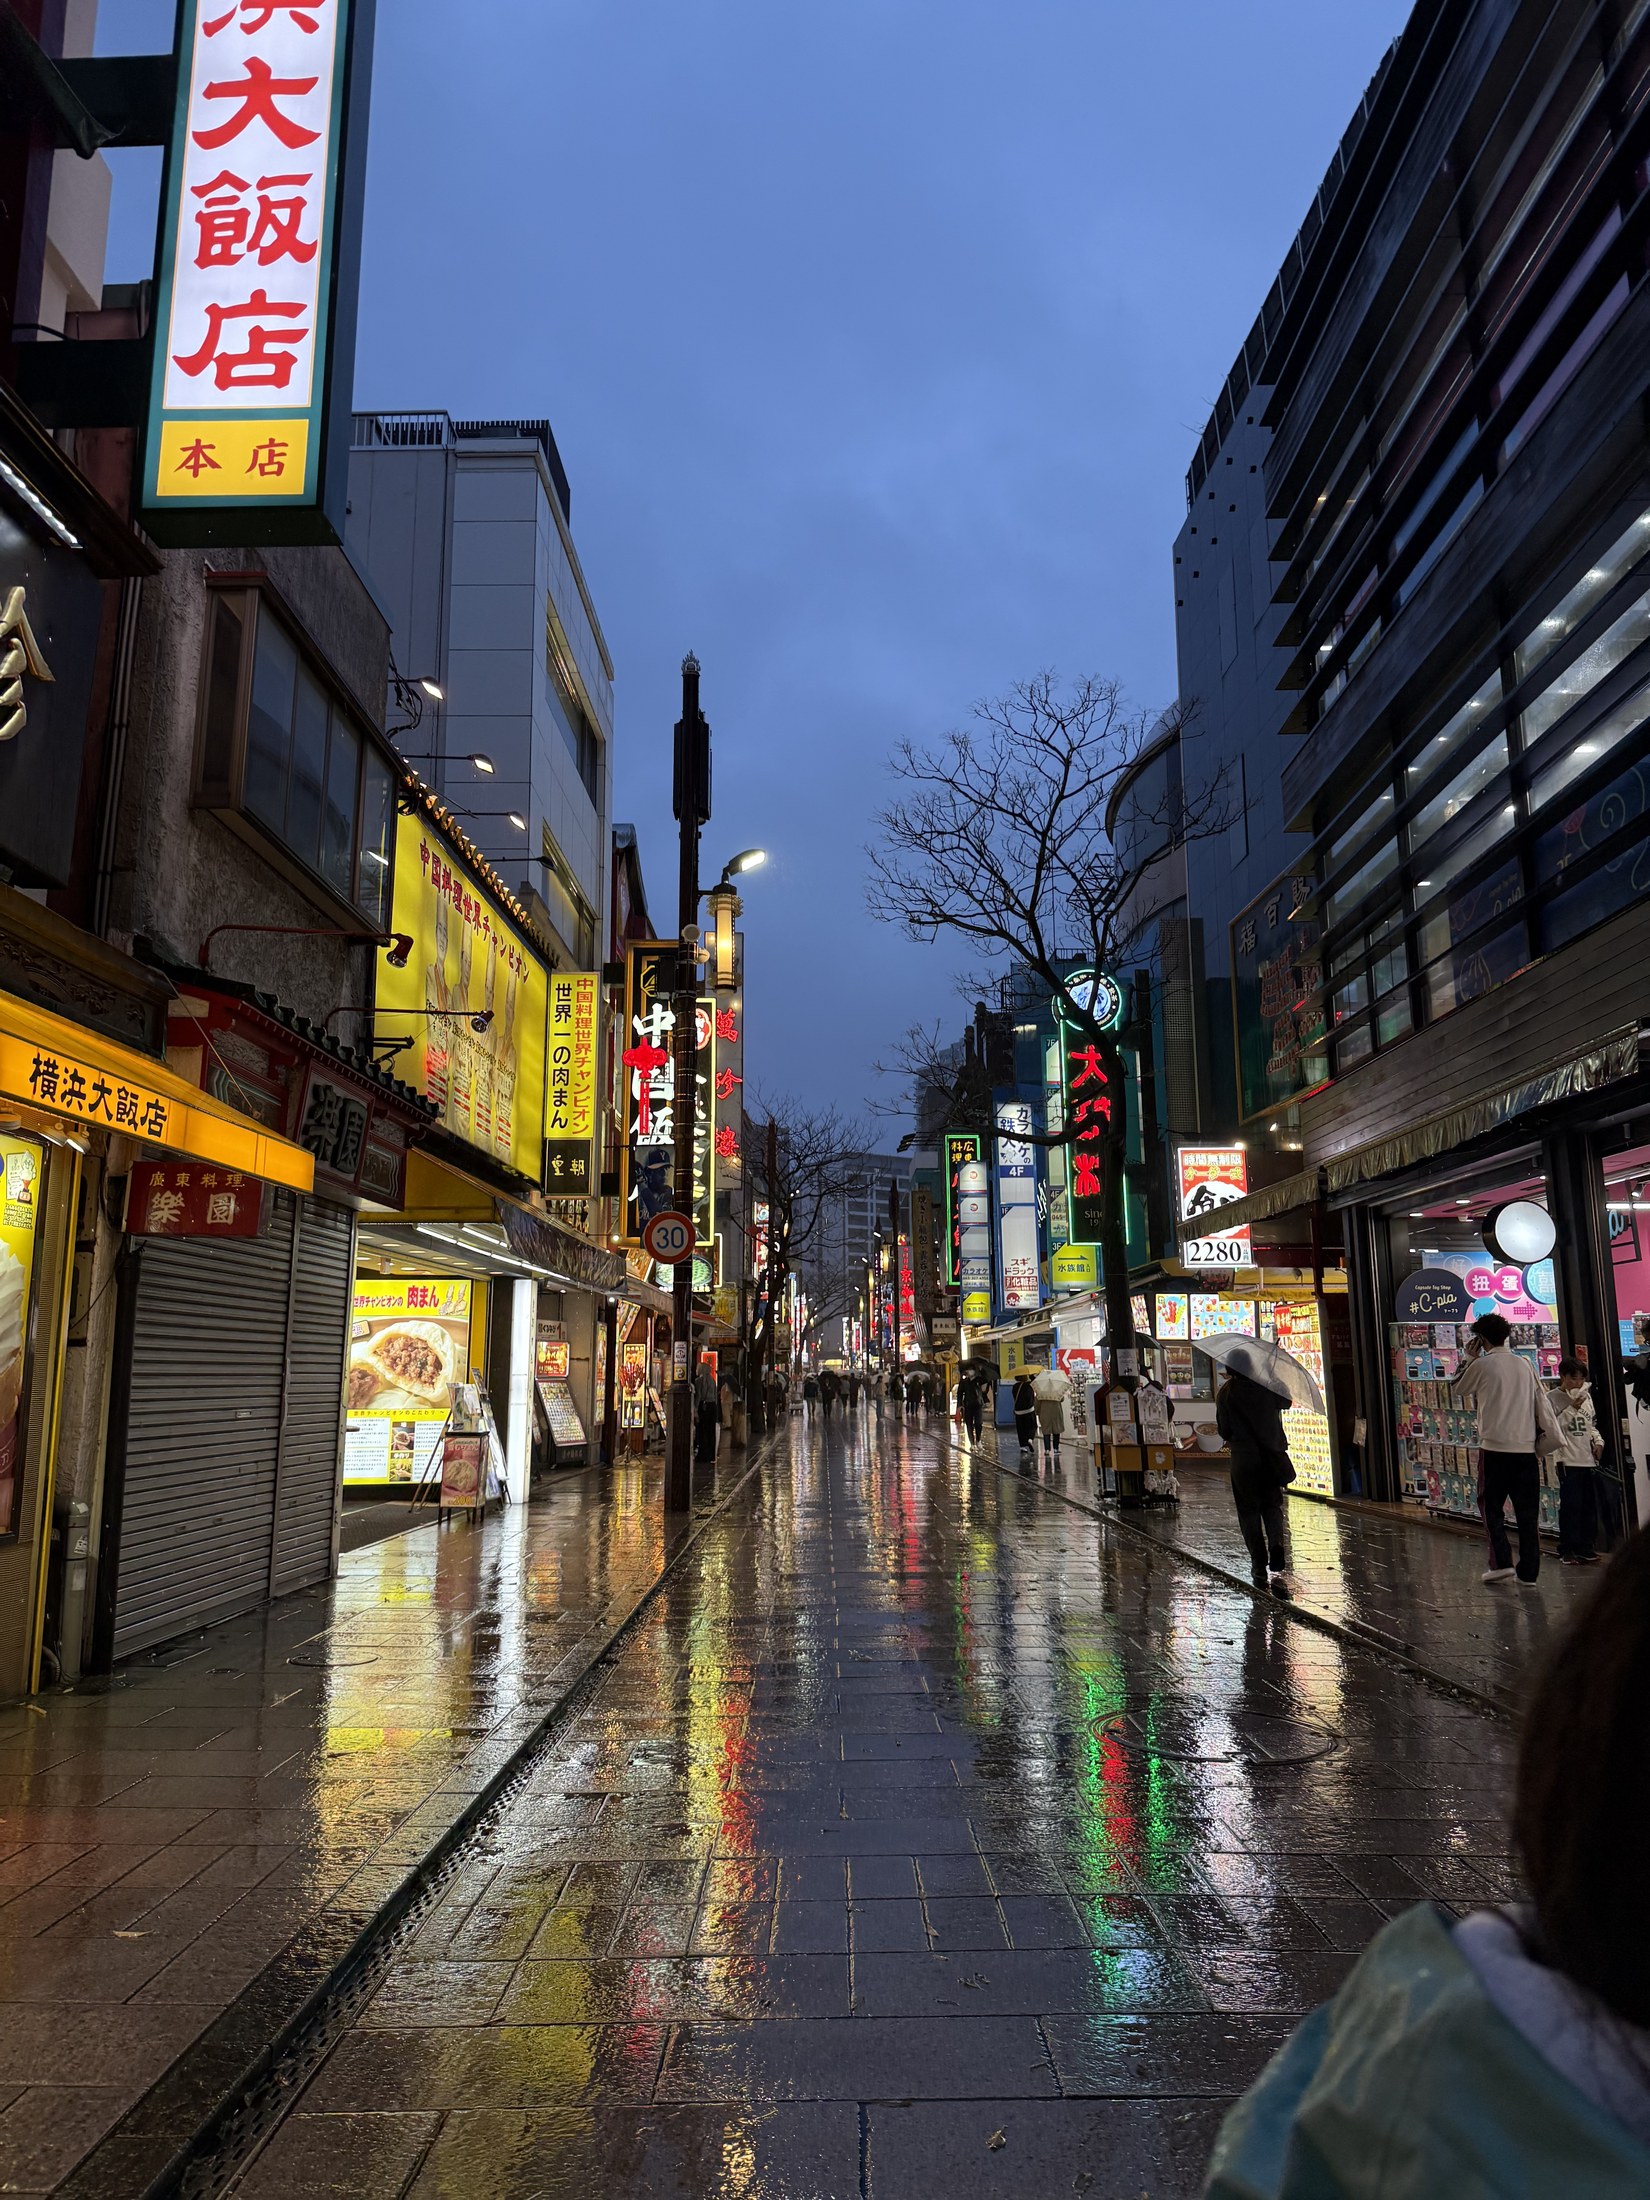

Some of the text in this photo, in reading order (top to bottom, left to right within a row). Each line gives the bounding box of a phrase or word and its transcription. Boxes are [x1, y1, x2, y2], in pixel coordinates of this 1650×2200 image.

[173, 437, 290, 480] 本店
[420, 838, 530, 984] 中国料理世界チャンピオン
[550, 983, 572, 1129] 世界一の肉まん
[572, 978, 594, 1135] 中国料理世界チャンピオン
[29, 1053, 169, 1139] 横浜大飯店
[1017, 1107, 1031, 1164] カラケの
[150, 1171, 245, 1189] 廣東料理
[1009, 1166, 1024, 1177] 4F
[150, 1192, 237, 1226] 樂園
[656, 1226, 684, 1249] 30
[1011, 1257, 1031, 1266] スギ
[1189, 1241, 1242, 1262] 2280
[1005, 1267, 1037, 1275] ドラッグ
[1058, 1263, 1085, 1272] 水族館
[1012, 1277, 1037, 1286] 化粧品
[1472, 1275, 1519, 1292] 扭蛋
[353, 1284, 439, 1309] 世界チャンピオンの 肉まん
